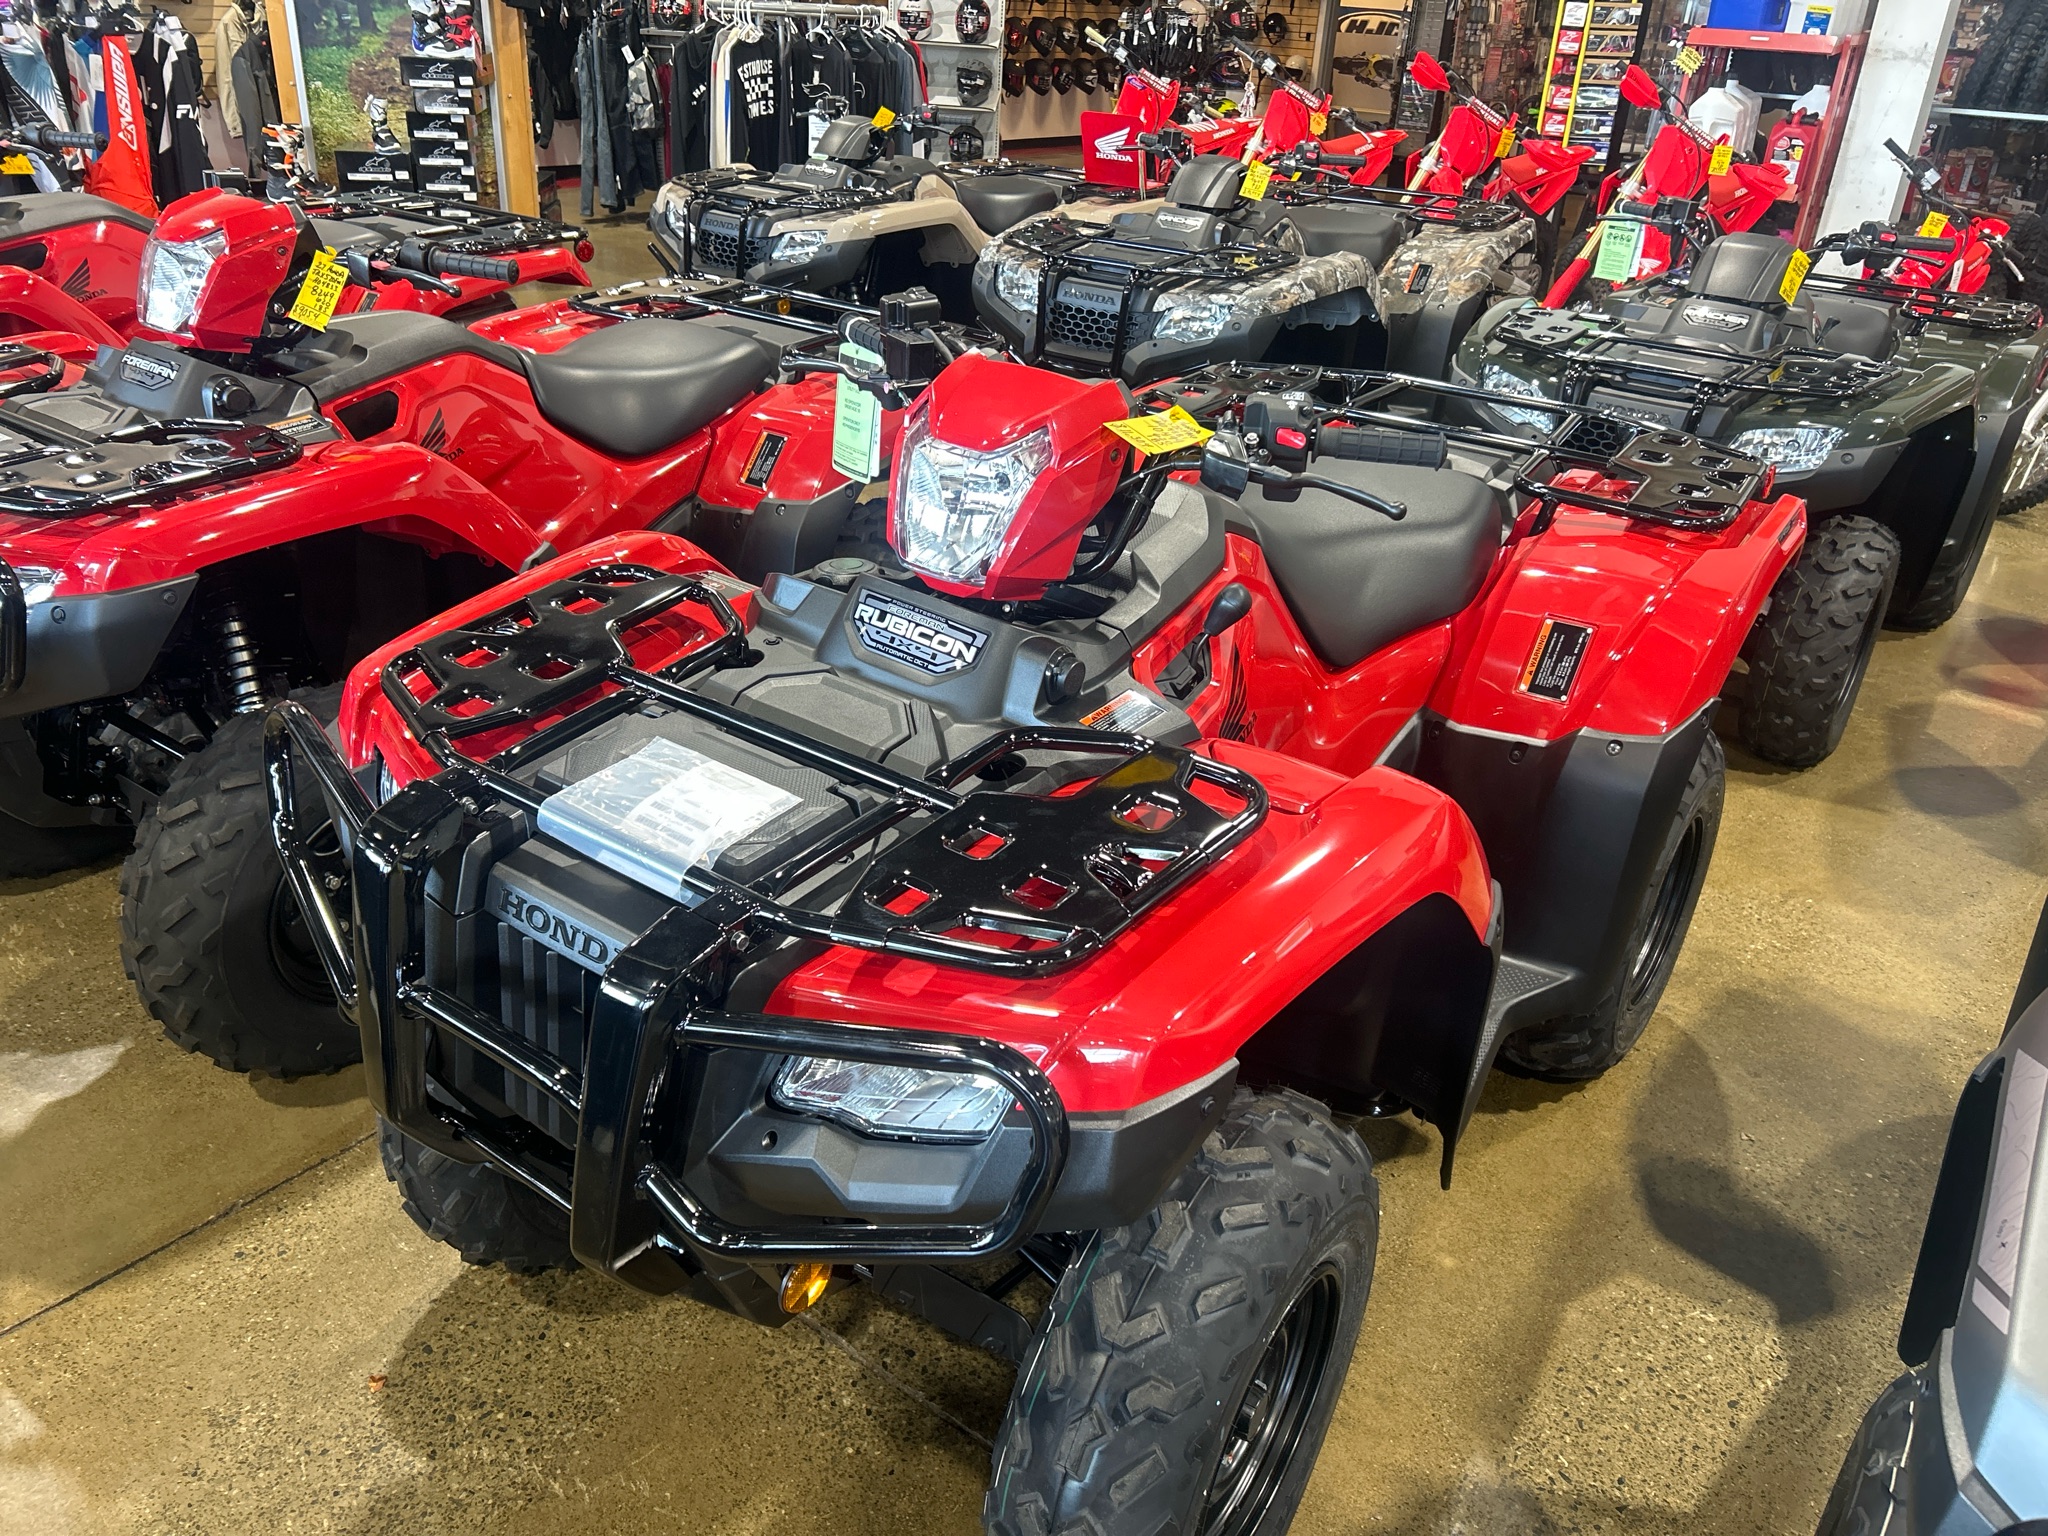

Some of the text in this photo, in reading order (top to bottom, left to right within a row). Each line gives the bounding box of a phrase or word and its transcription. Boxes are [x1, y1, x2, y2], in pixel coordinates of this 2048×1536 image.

[1096, 152, 1133, 162] HONDA
[76, 288, 108, 303] ONDA
[311, 285, 335, 303] 8249
[1063, 288, 1116, 306] HONDA
[121, 354, 177, 380] FOREMAN
[887, 605, 946, 631] FOREMAN
[892, 599, 947, 623] POWER STEERING
[854, 603, 978, 664] RUBICON
[875, 643, 929, 669] AUTOMATIC DCT
[1530, 634, 1547, 667] WARNING
[497, 887, 622, 969] HOND
